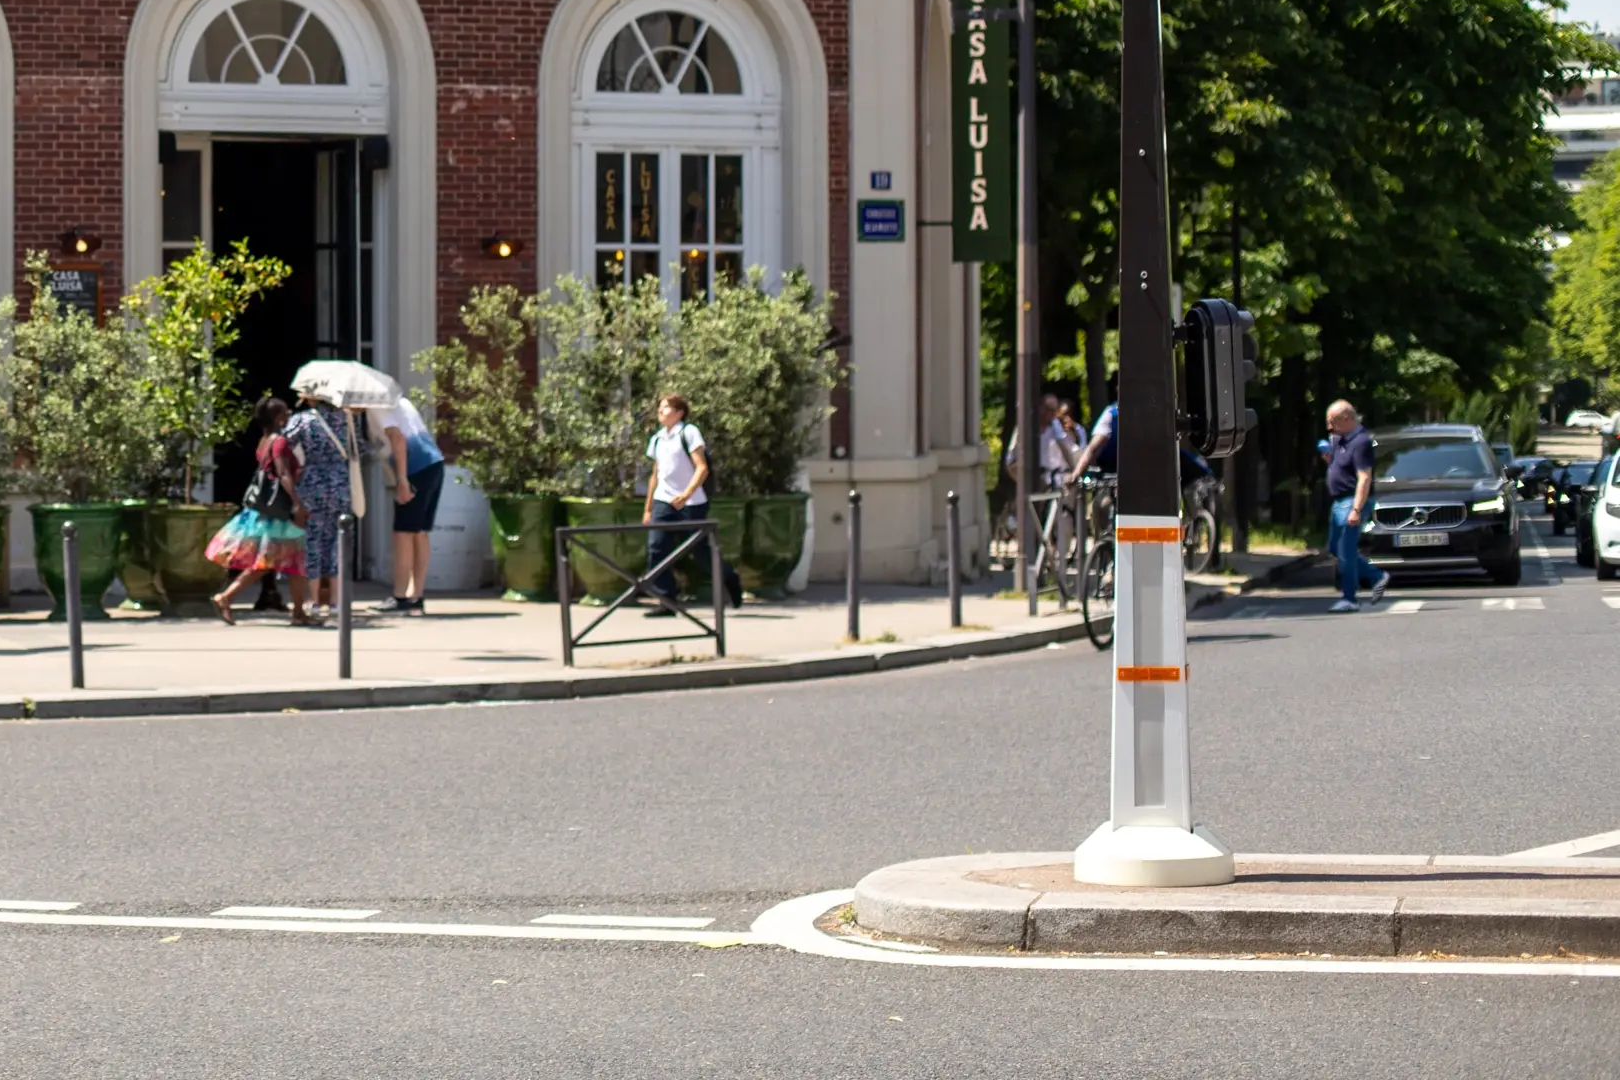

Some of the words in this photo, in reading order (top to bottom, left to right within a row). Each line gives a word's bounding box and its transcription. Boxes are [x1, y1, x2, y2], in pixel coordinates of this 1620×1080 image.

[605, 169, 616, 230] CASA
[641, 161, 651, 237] LUISA
[969, 97, 989, 230] LUISA
[52, 271, 80, 280] CASA
